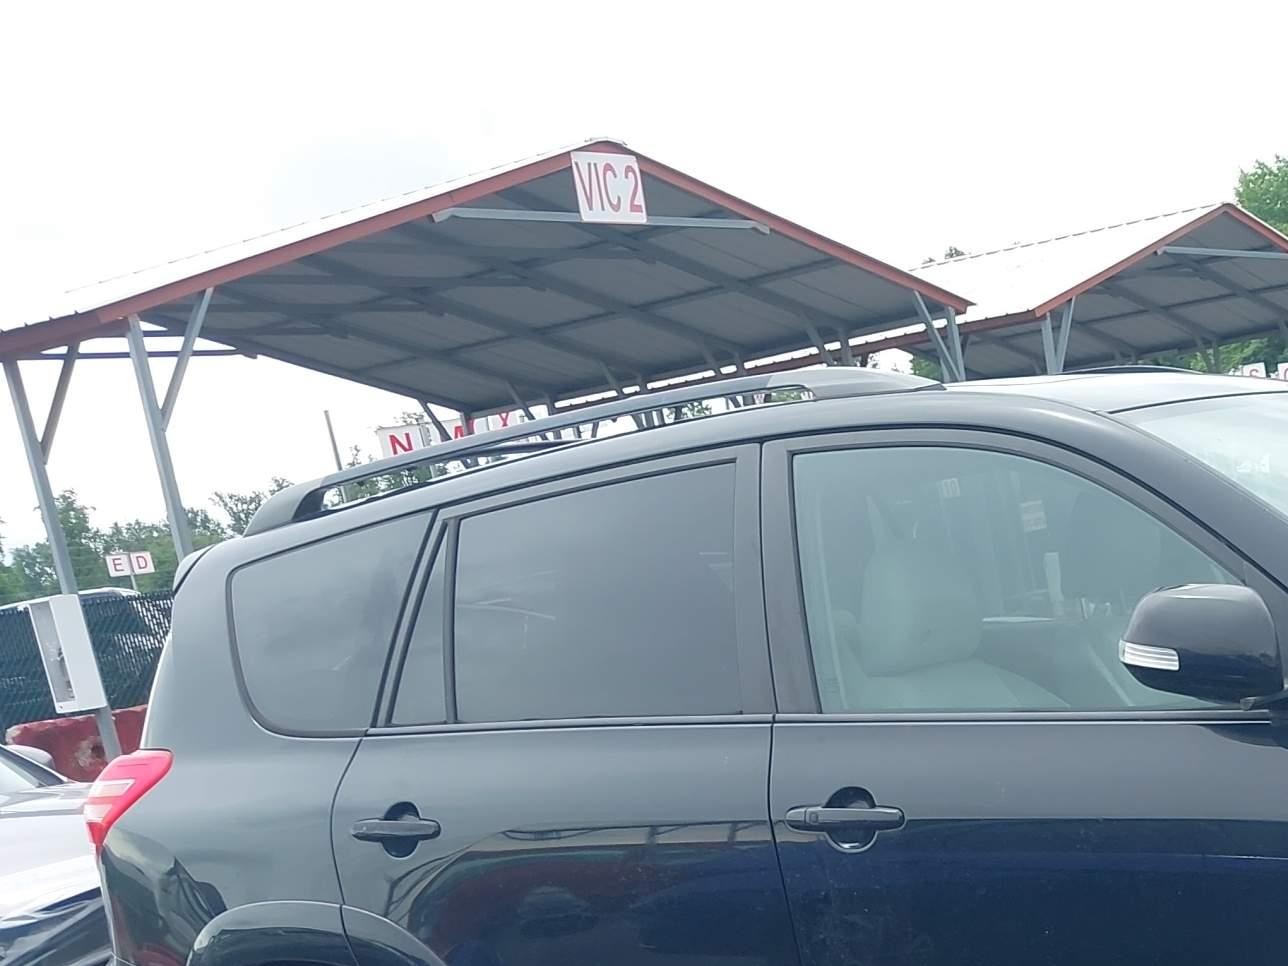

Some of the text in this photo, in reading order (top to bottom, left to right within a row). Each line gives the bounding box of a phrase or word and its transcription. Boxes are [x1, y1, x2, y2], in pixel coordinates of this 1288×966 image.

[574, 160, 644, 212] VIC 2
[388, 432, 414, 455] N
[111, 555, 148, 572] E D
